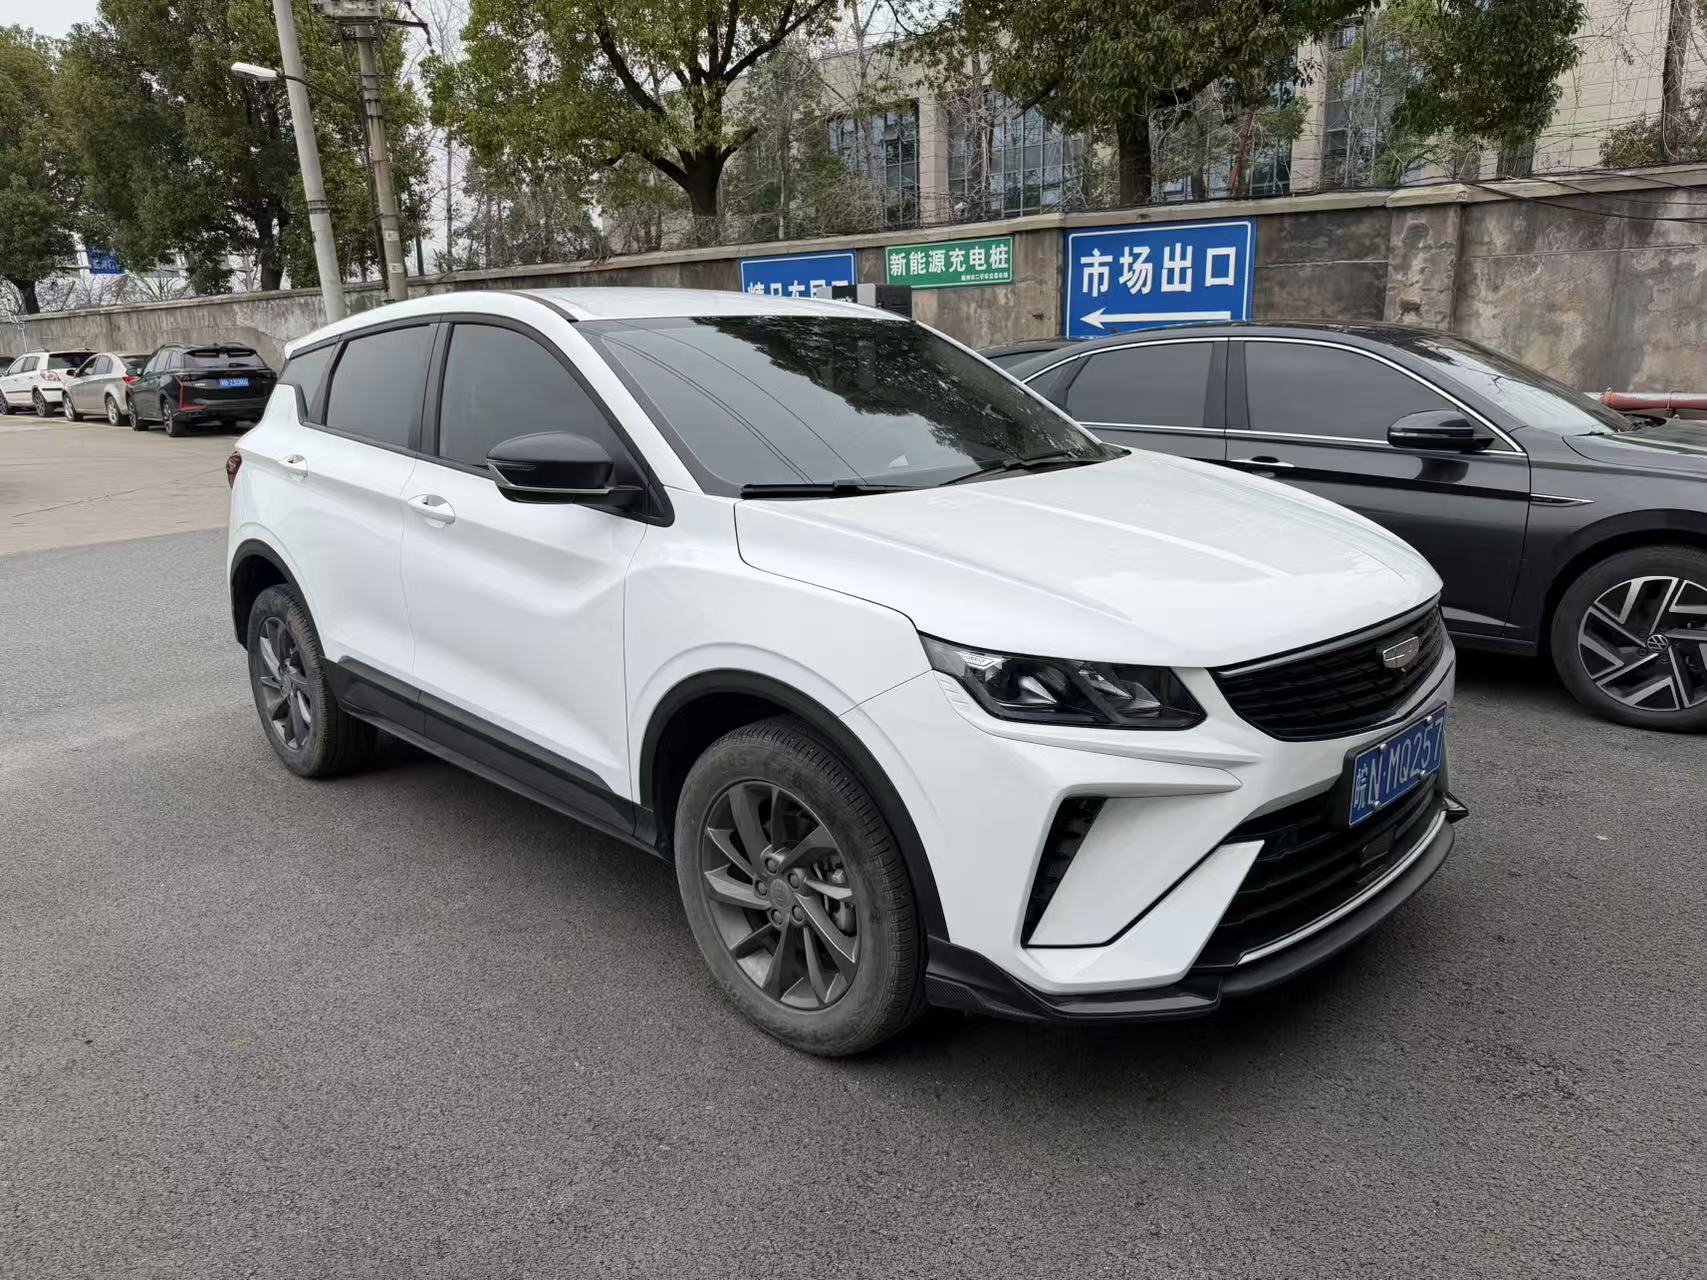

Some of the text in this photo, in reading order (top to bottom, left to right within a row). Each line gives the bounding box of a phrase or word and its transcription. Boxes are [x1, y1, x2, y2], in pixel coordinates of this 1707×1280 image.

[889, 243, 1009, 276] 新能源充电桩
[1080, 242, 1237, 297] 市场出口
